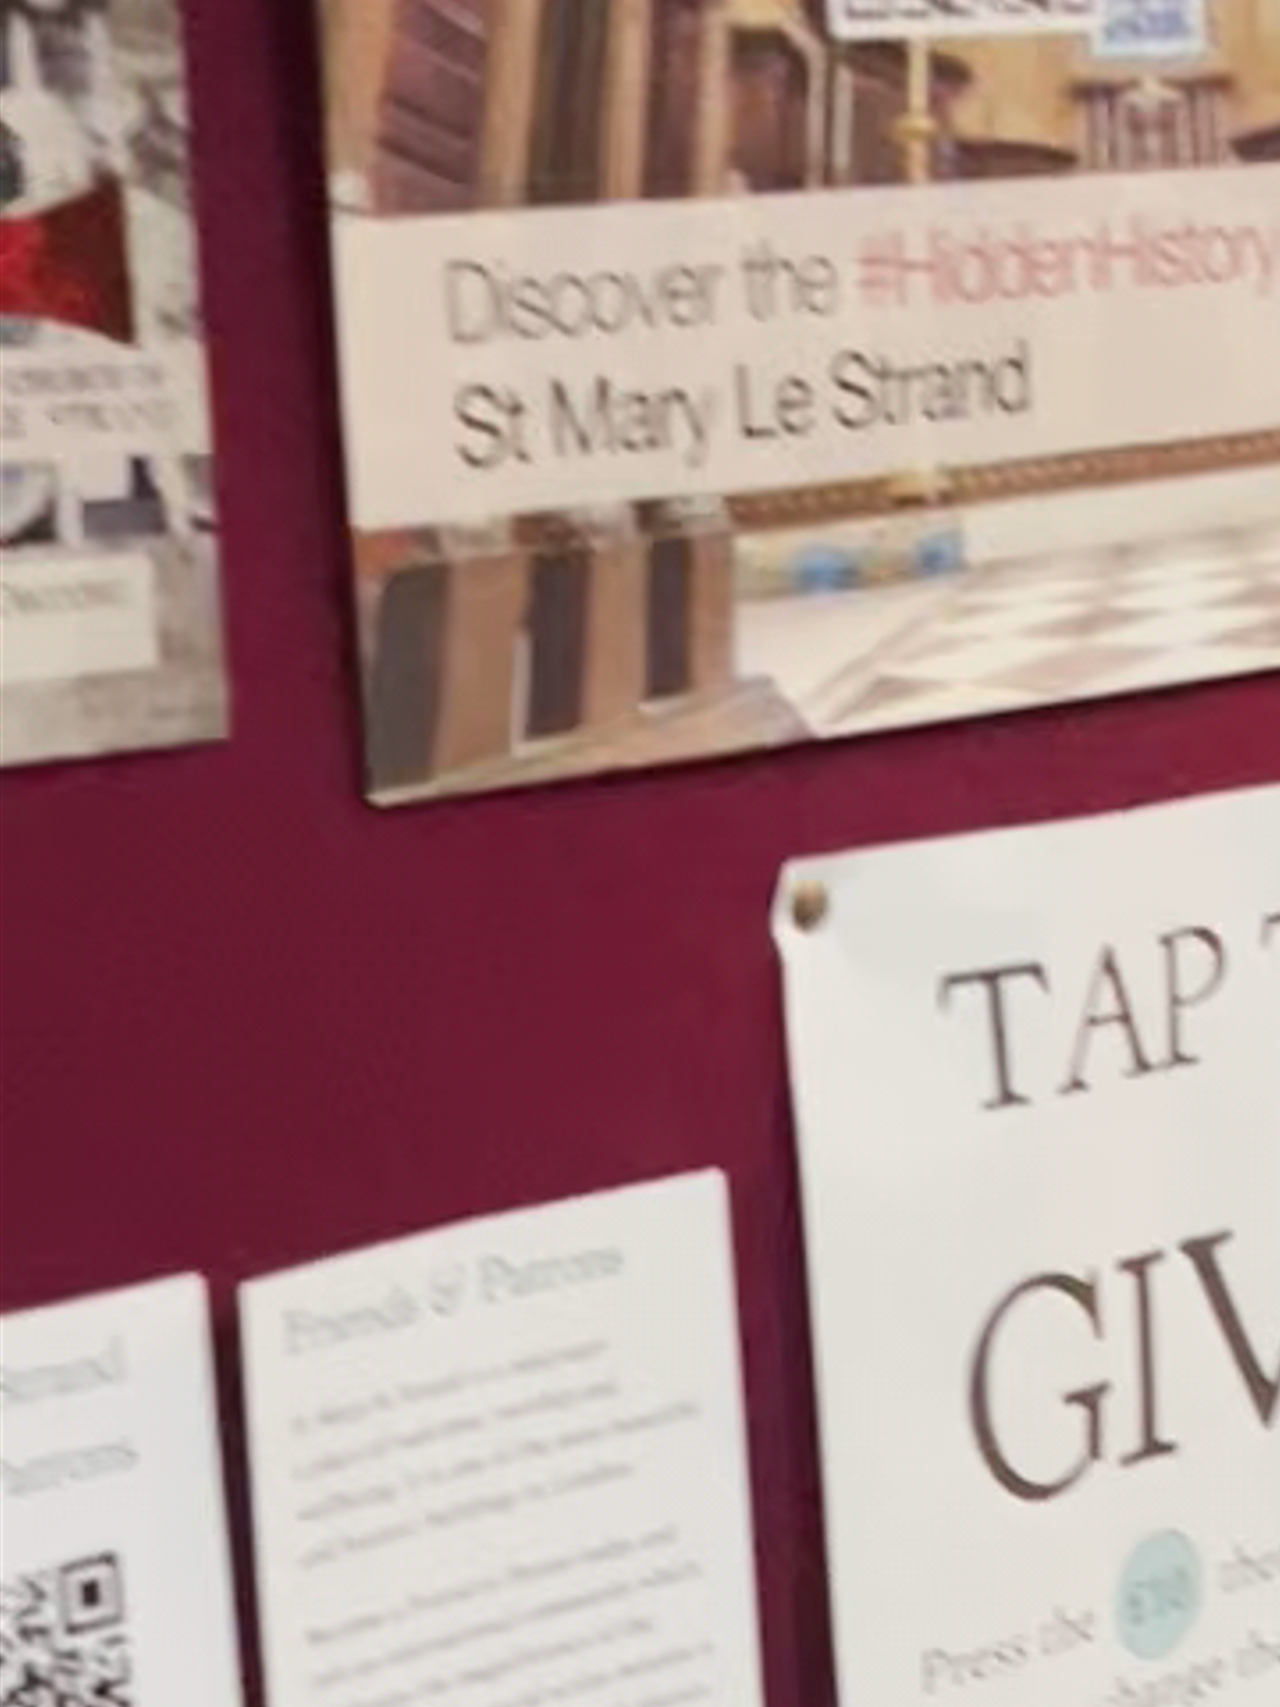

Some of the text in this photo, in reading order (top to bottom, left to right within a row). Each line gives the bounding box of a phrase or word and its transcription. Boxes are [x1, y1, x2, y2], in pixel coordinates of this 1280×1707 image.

[441, 259, 723, 345] Discover
[744, 241, 838, 322] the
[856, 212, 1278, 311] #HiddenHistory
[454, 340, 1031, 471] St Mary Le Strand
[936, 925, 1228, 1111] TAP
[281, 1285, 421, 1355] Friends
[478, 1247, 625, 1304] Patrons
[920, 1638, 1030, 1695] Press
[1037, 1604, 1096, 1657] the
